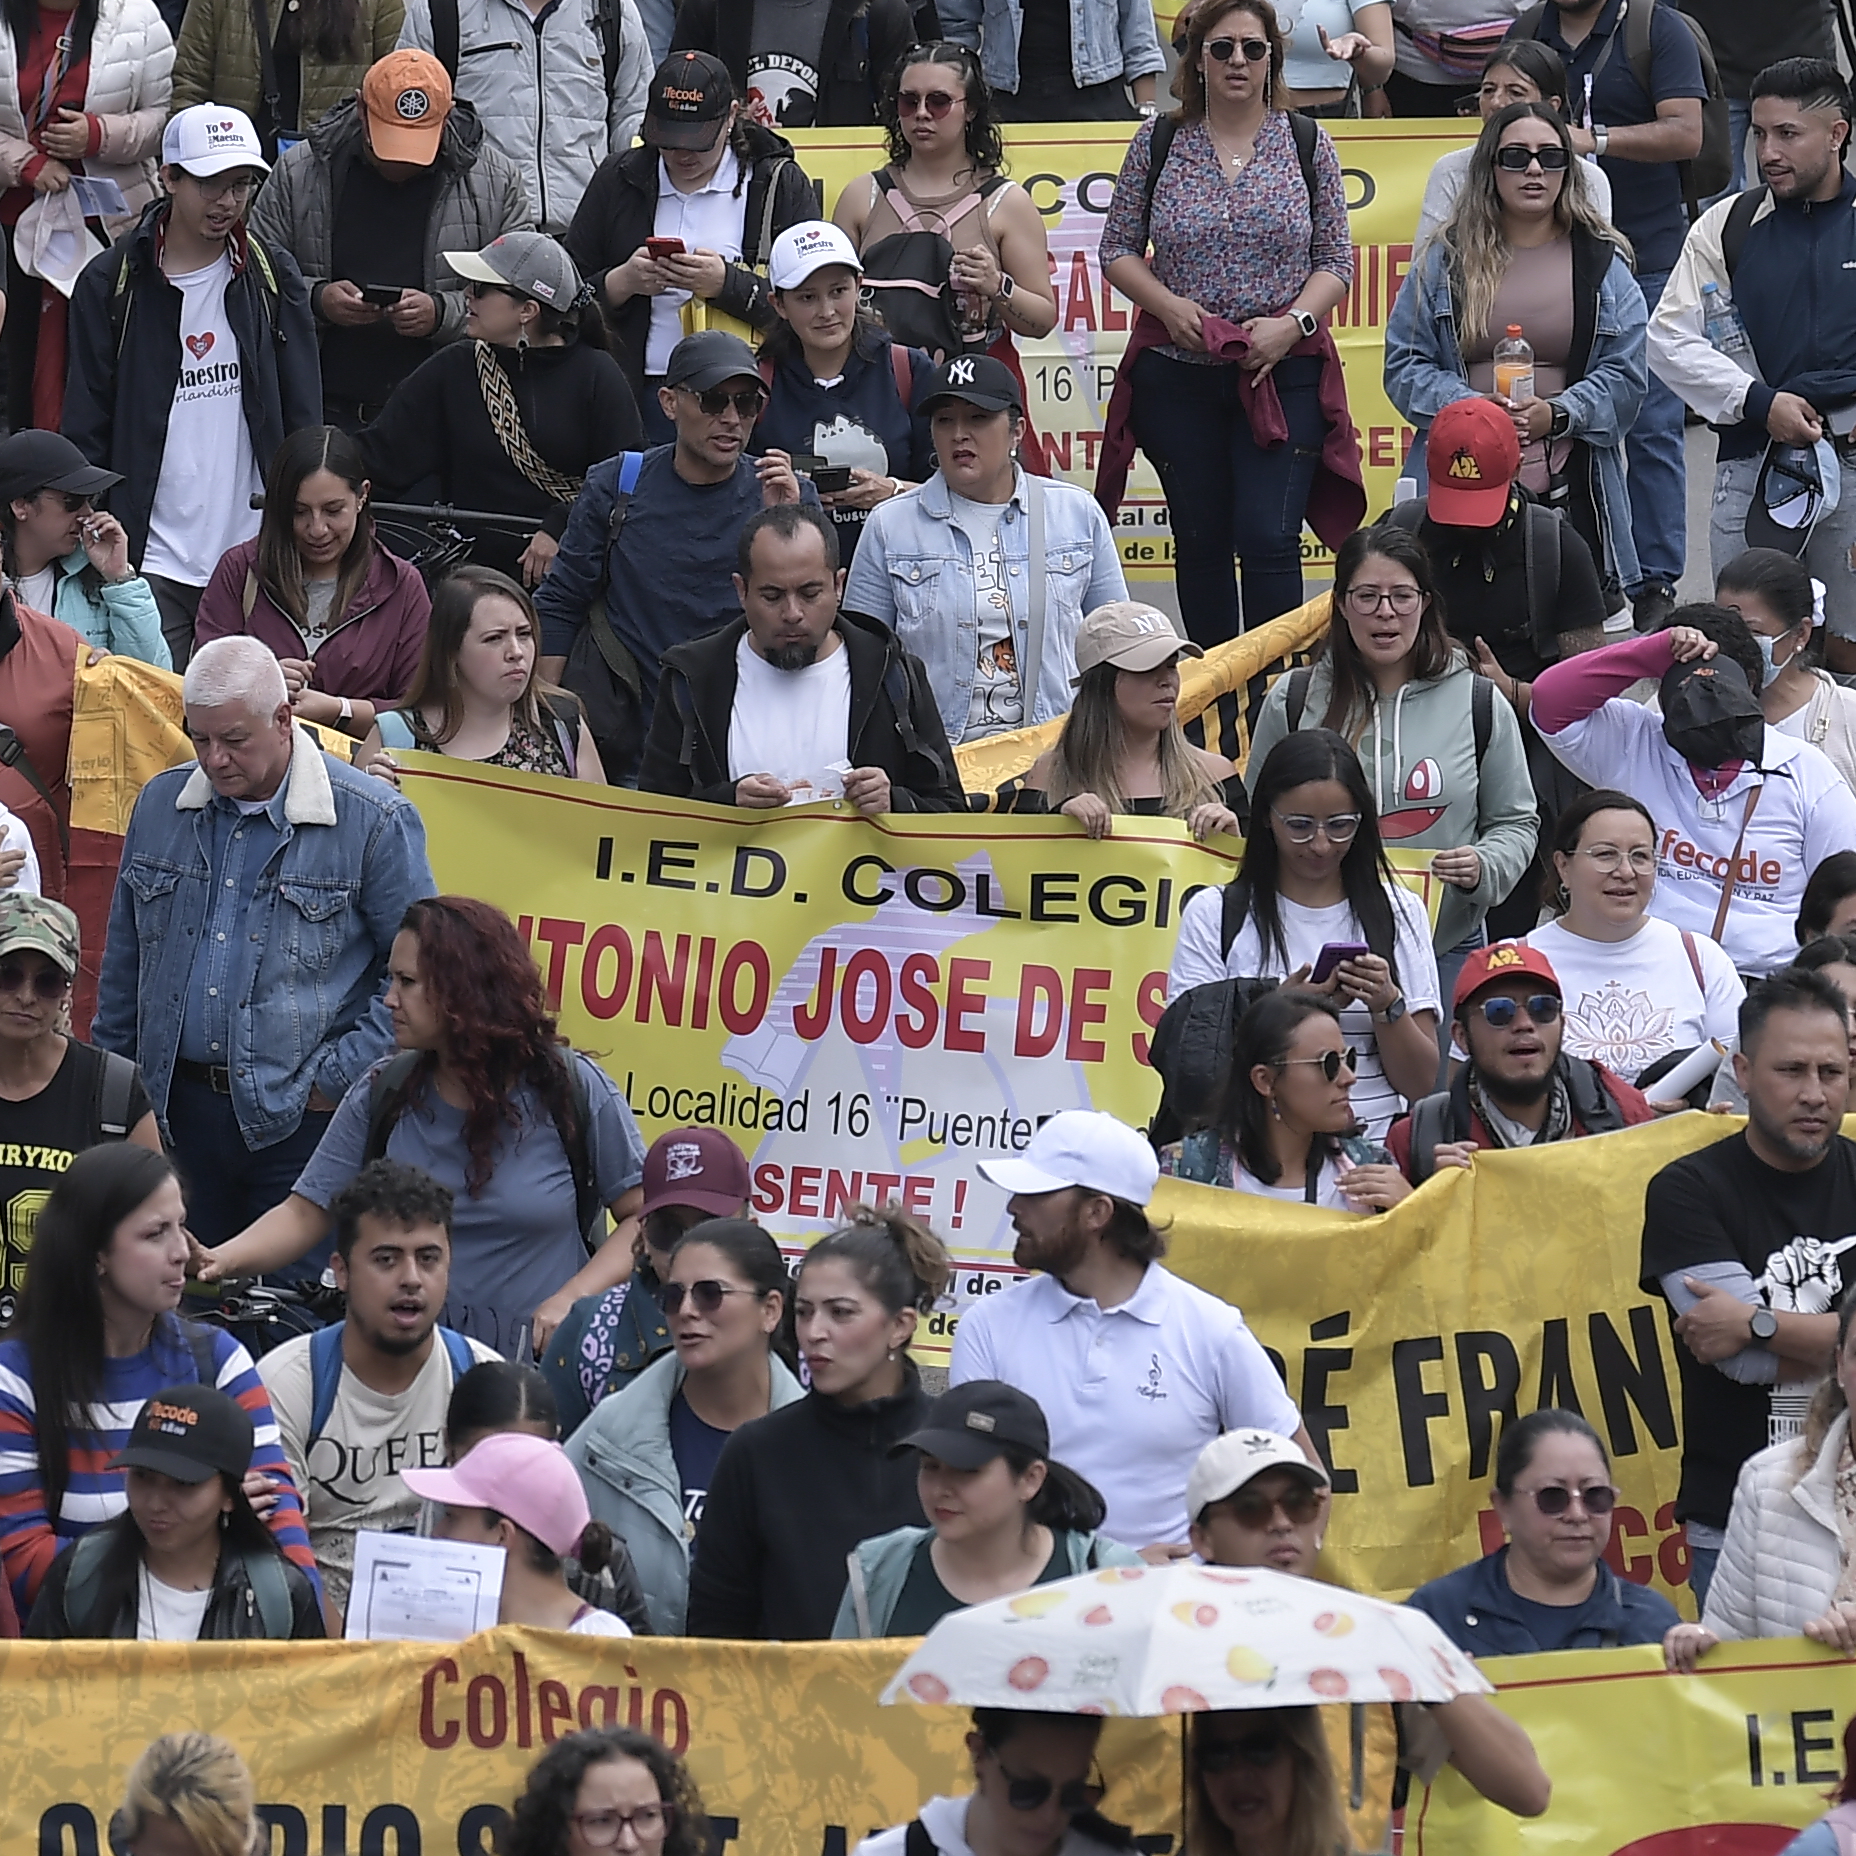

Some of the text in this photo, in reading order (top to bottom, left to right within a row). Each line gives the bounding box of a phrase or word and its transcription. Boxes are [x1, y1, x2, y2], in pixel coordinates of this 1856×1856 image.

[205, 123, 220, 134] Yo
[1036, 364, 1074, 405] 16
[594, 835, 810, 906] I.E.D.
[791, 947, 990, 1056] JOSE
[1013, 963, 1113, 1064] DE
[623, 1070, 810, 1136] Localidad
[825, 1088, 871, 1138] 16
[966, 1272, 1004, 1297] de
[419, 1649, 691, 1758] Colegio
